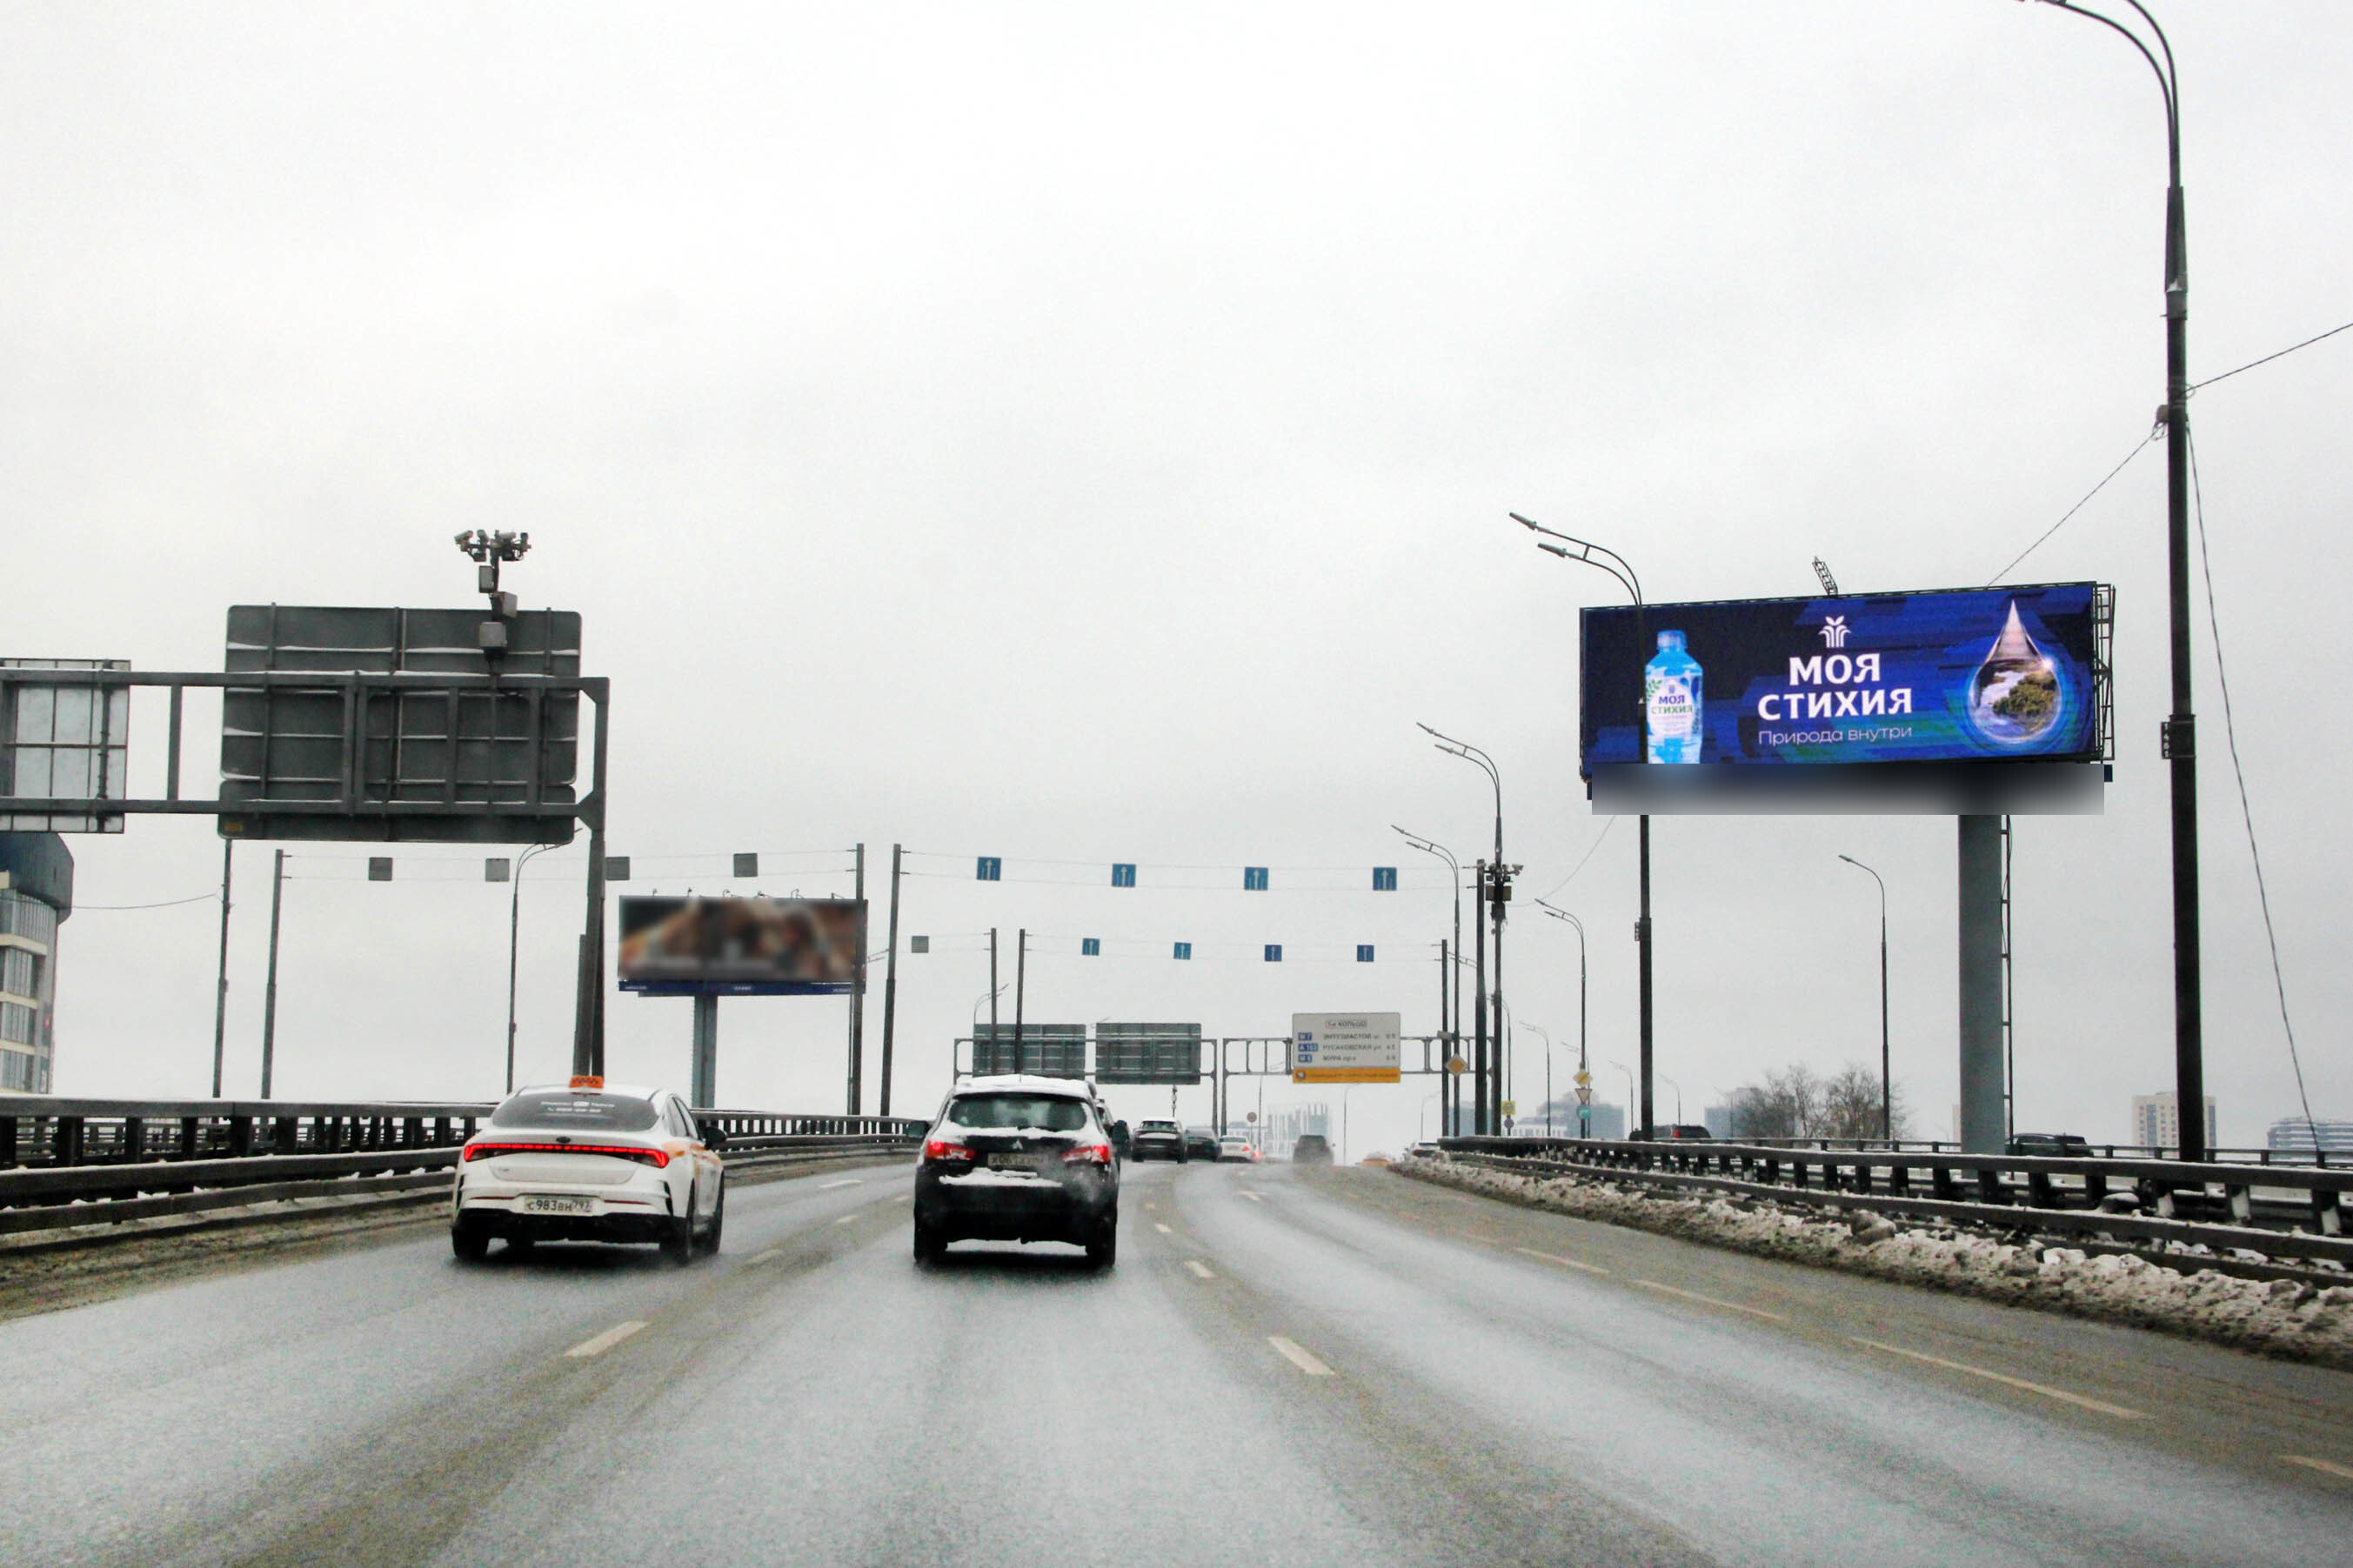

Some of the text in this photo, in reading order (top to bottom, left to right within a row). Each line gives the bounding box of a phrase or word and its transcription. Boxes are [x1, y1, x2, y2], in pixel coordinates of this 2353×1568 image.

[1789, 652, 1881, 685] МОЯ
[1658, 694, 1686, 704] МОЯ
[1757, 687, 1913, 721] СТИХИЯ
[1758, 724, 1913, 745] Природа внутри
